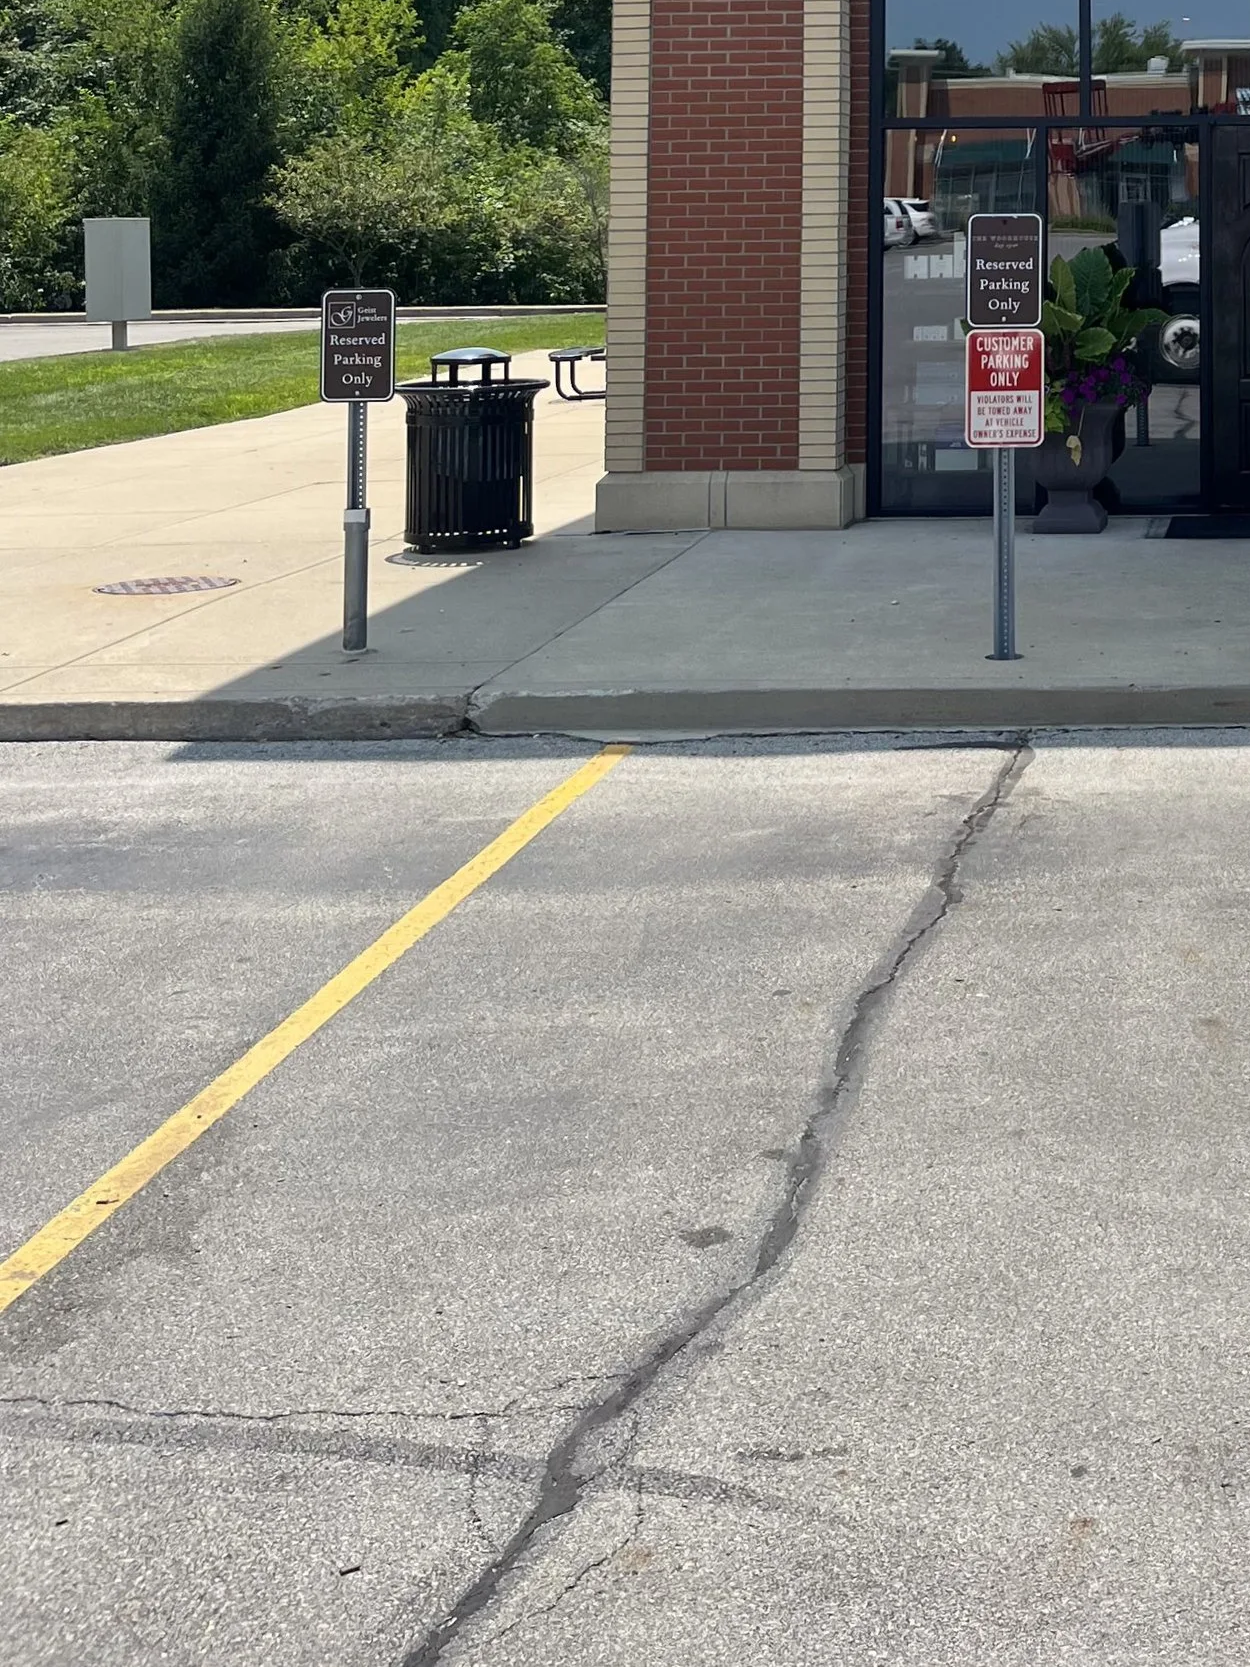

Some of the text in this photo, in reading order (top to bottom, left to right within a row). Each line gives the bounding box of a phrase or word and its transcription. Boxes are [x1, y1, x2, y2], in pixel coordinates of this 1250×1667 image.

[975, 257, 1034, 271] Reserved
[979, 278, 1030, 293] Parking
[357, 306, 377, 314] Geist
[988, 297, 1021, 313] Only
[357, 314, 388, 323] Jewelers
[330, 333, 385, 345] Reserved
[976, 336, 1034, 351] CUSTOMER
[334, 353, 382, 367] Parking
[981, 354, 1029, 369] PARKING
[342, 372, 373, 387] Only
[990, 372, 1020, 387] ONLY
[976, 394, 1033, 404] VIOLATORS WILL
[977, 406, 1033, 415] BE TOWED AWAY
[984, 417, 1024, 427] AT VEHICLE
[973, 429, 1036, 439] OWNER'S EXPENSE
